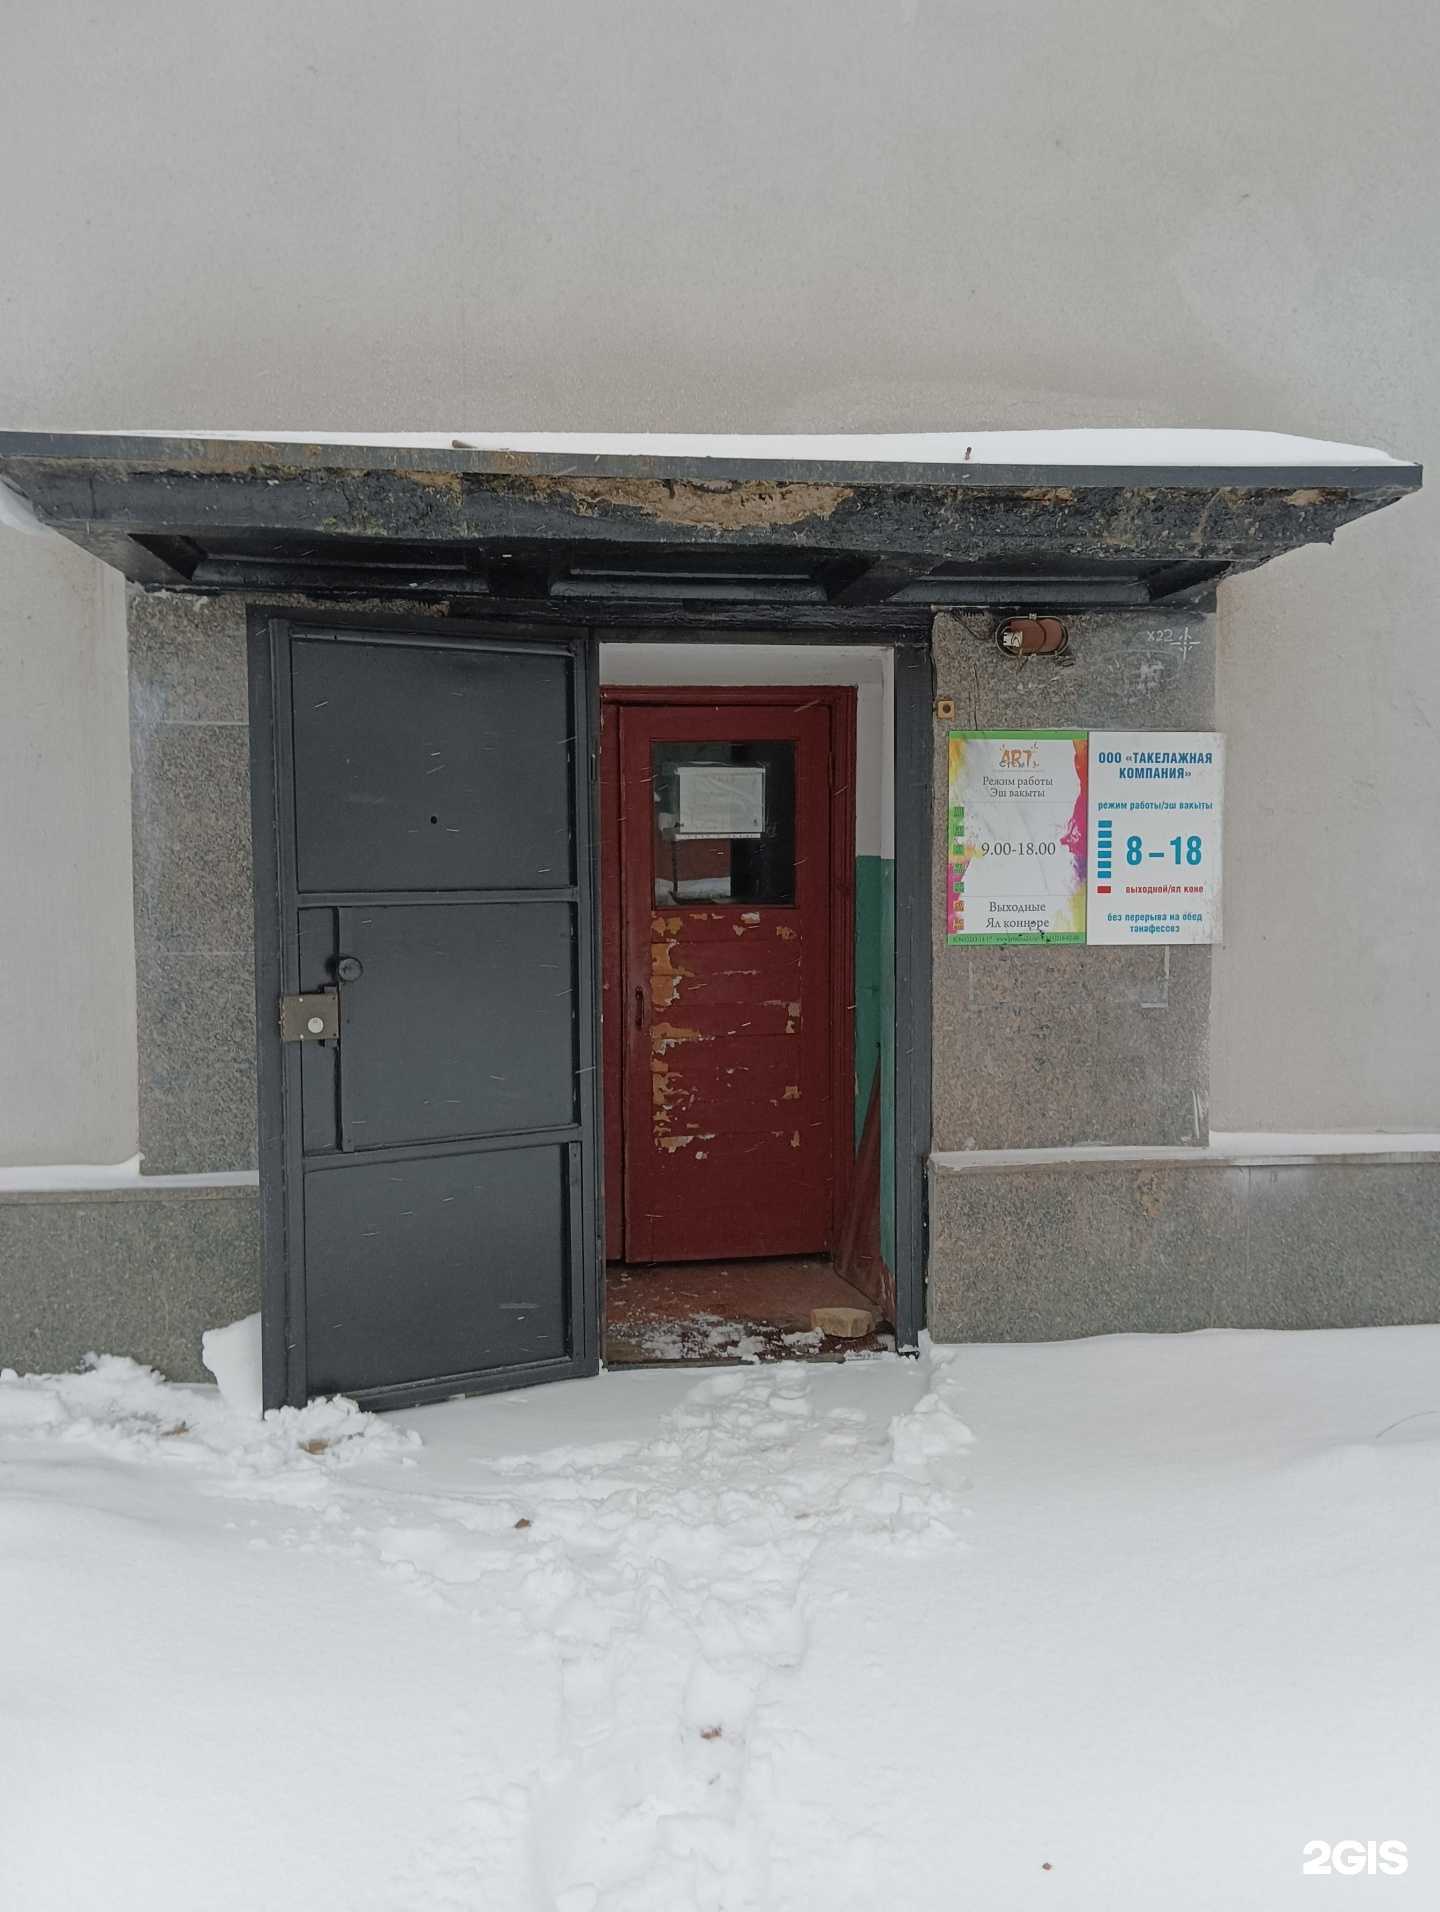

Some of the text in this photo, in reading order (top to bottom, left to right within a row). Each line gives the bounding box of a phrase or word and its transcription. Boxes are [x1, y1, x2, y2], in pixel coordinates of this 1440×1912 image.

[1098, 752, 1213, 764] ООО «ТАКЕЛАЖНАЯ
[1119, 767, 1192, 779] КОМПАНИЯ»
[983, 776, 1054, 788] Режим работы
[990, 788, 1007, 799] Эш
[1098, 801, 1128, 811] режим
[981, 841, 1057, 857] 9.00-18.00
[989, 901, 1047, 913] Выходные
[985, 917, 1001, 929] Ял
[1107, 912, 1203, 923] без перерыва на обед
